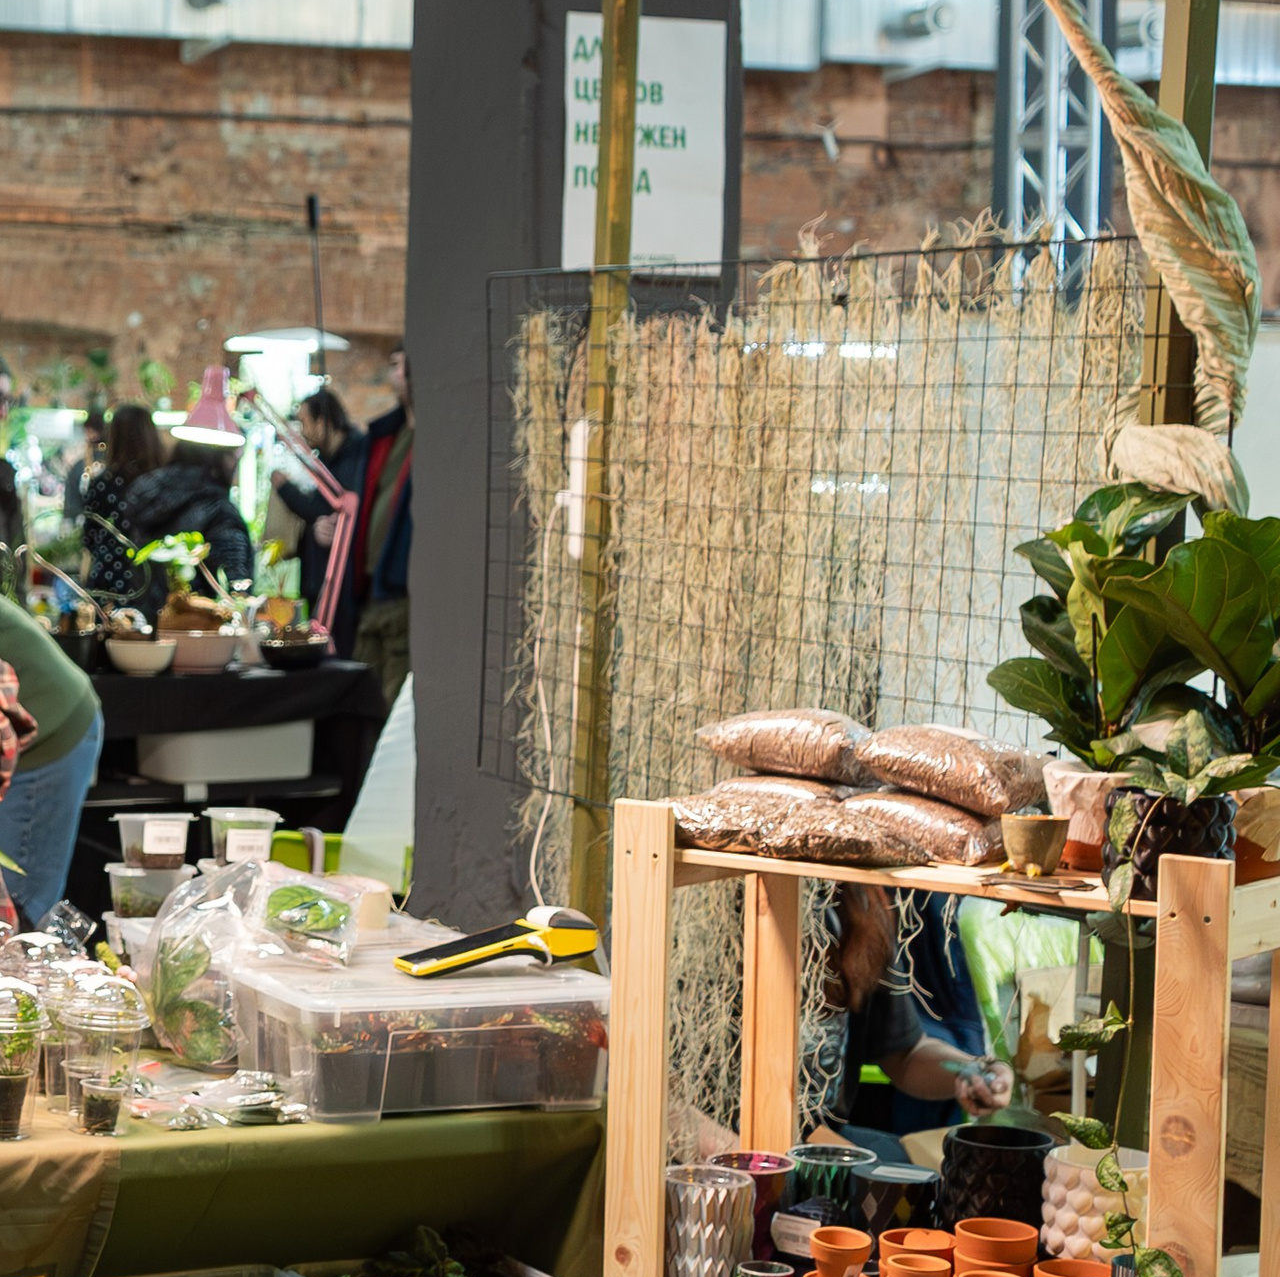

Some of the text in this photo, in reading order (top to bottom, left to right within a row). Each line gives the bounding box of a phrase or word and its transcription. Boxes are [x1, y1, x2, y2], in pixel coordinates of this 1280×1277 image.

[573, 34, 603, 61] ДЛ
[575, 77, 664, 105] ЦВОВ
[634, 124, 687, 150] ЖЕН
